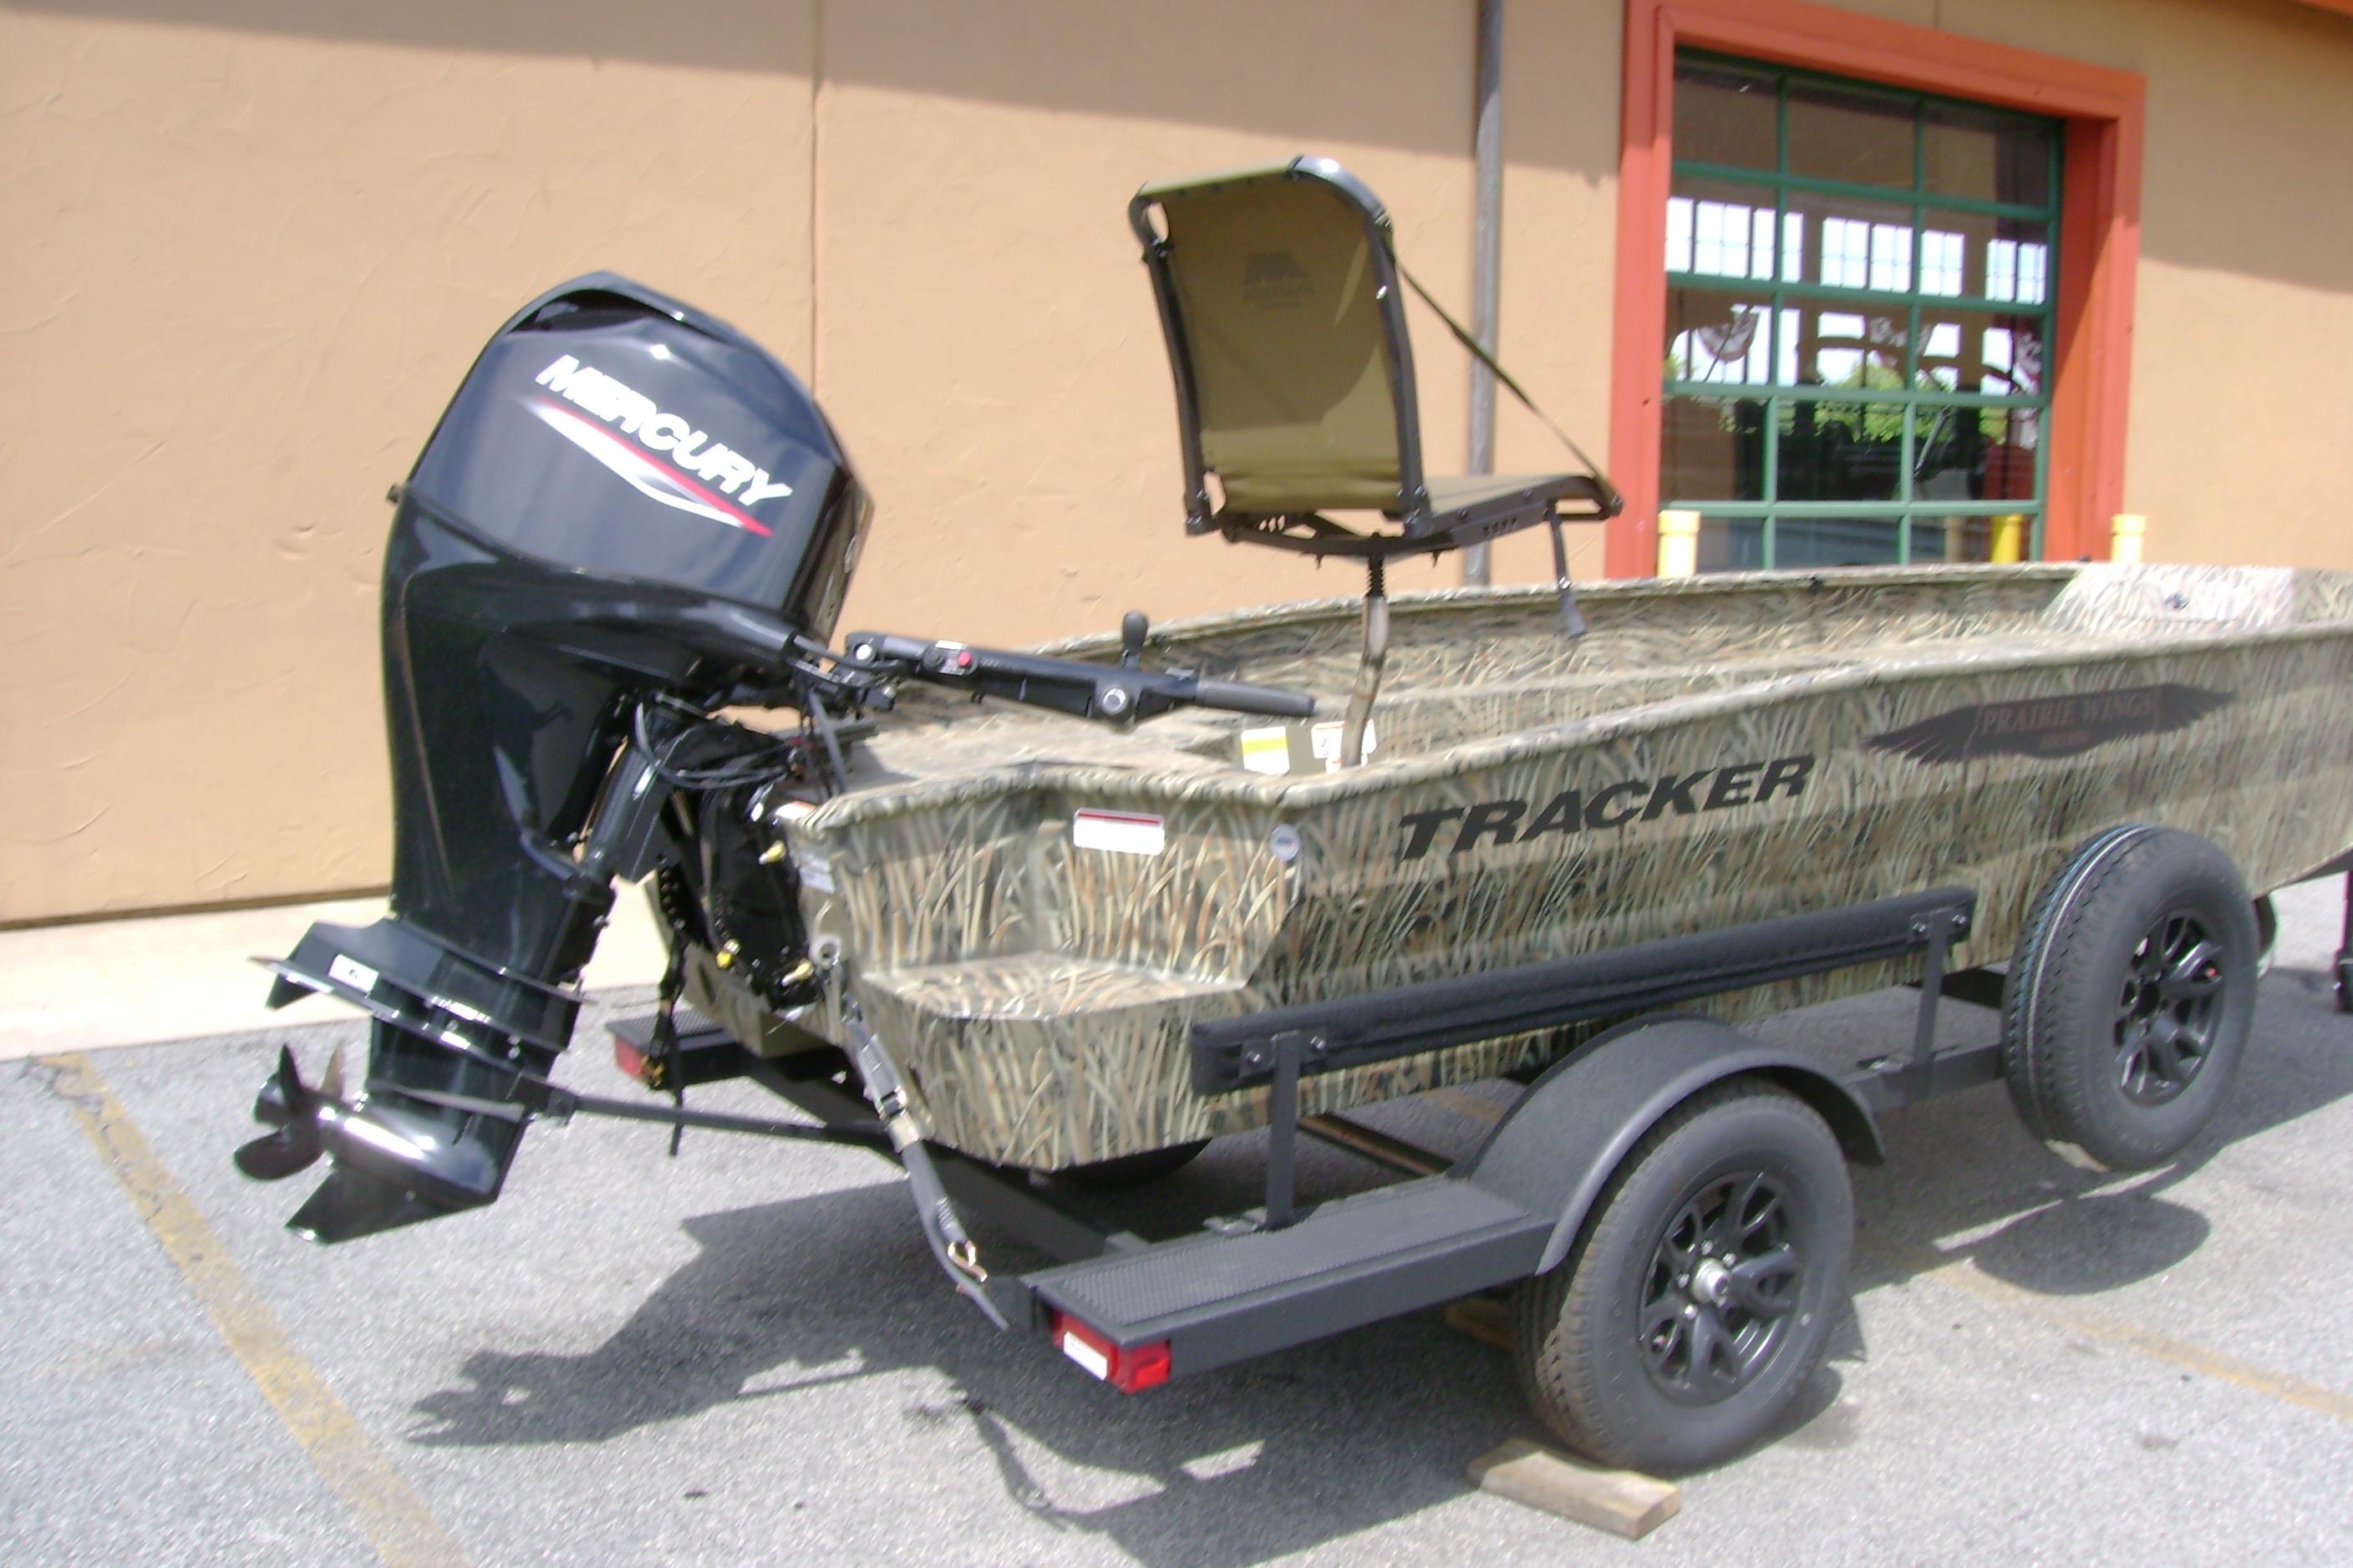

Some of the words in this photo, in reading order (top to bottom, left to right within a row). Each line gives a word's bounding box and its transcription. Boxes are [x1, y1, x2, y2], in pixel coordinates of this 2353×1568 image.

[535, 354, 793, 506] MERCURY
[1979, 699, 2078, 738] PRAIRIE
[1399, 755, 1815, 862] TRACKER
